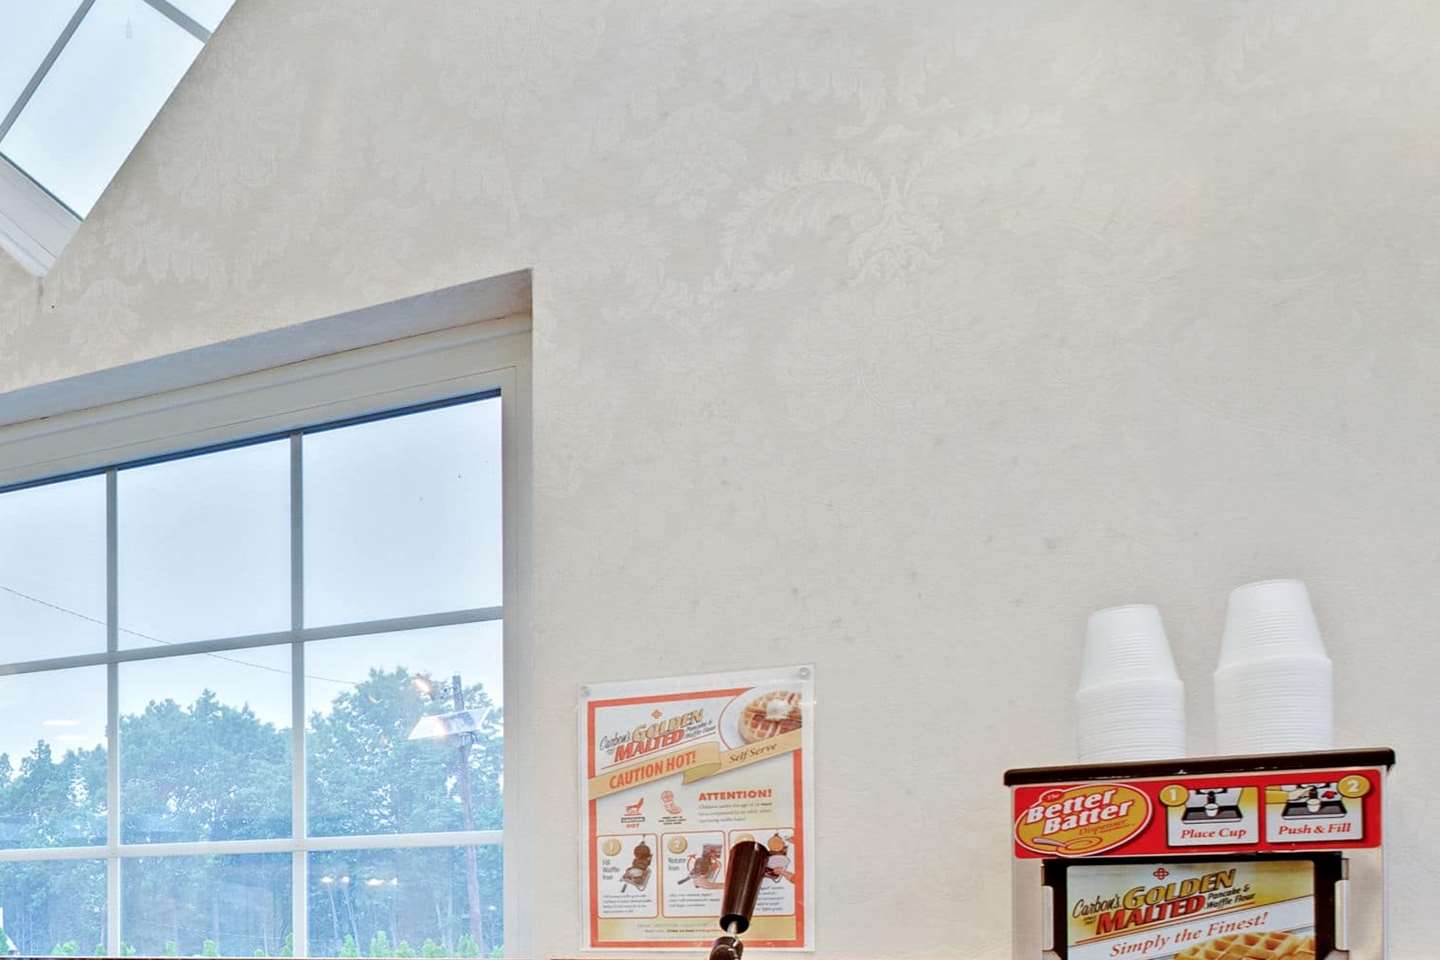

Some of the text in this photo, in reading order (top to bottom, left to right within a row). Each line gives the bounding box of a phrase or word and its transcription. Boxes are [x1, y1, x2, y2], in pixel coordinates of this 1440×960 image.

[614, 729, 685, 762] MALTED
[609, 751, 697, 789] CAUTION HOT!
[1347, 780, 1359, 793] 2
[698, 788, 772, 801] ATTENTION!
[1025, 789, 1118, 824] Better
[1170, 789, 1177, 801] 1
[1043, 801, 1133, 835] Batter
[1181, 828, 1247, 839] Place Cup
[1279, 823, 1352, 835] Push & Fill
[1123, 868, 1236, 910] GOLDEN
[1095, 895, 1206, 935] MALTED
[1110, 912, 1269, 957] Simply the Finest!
